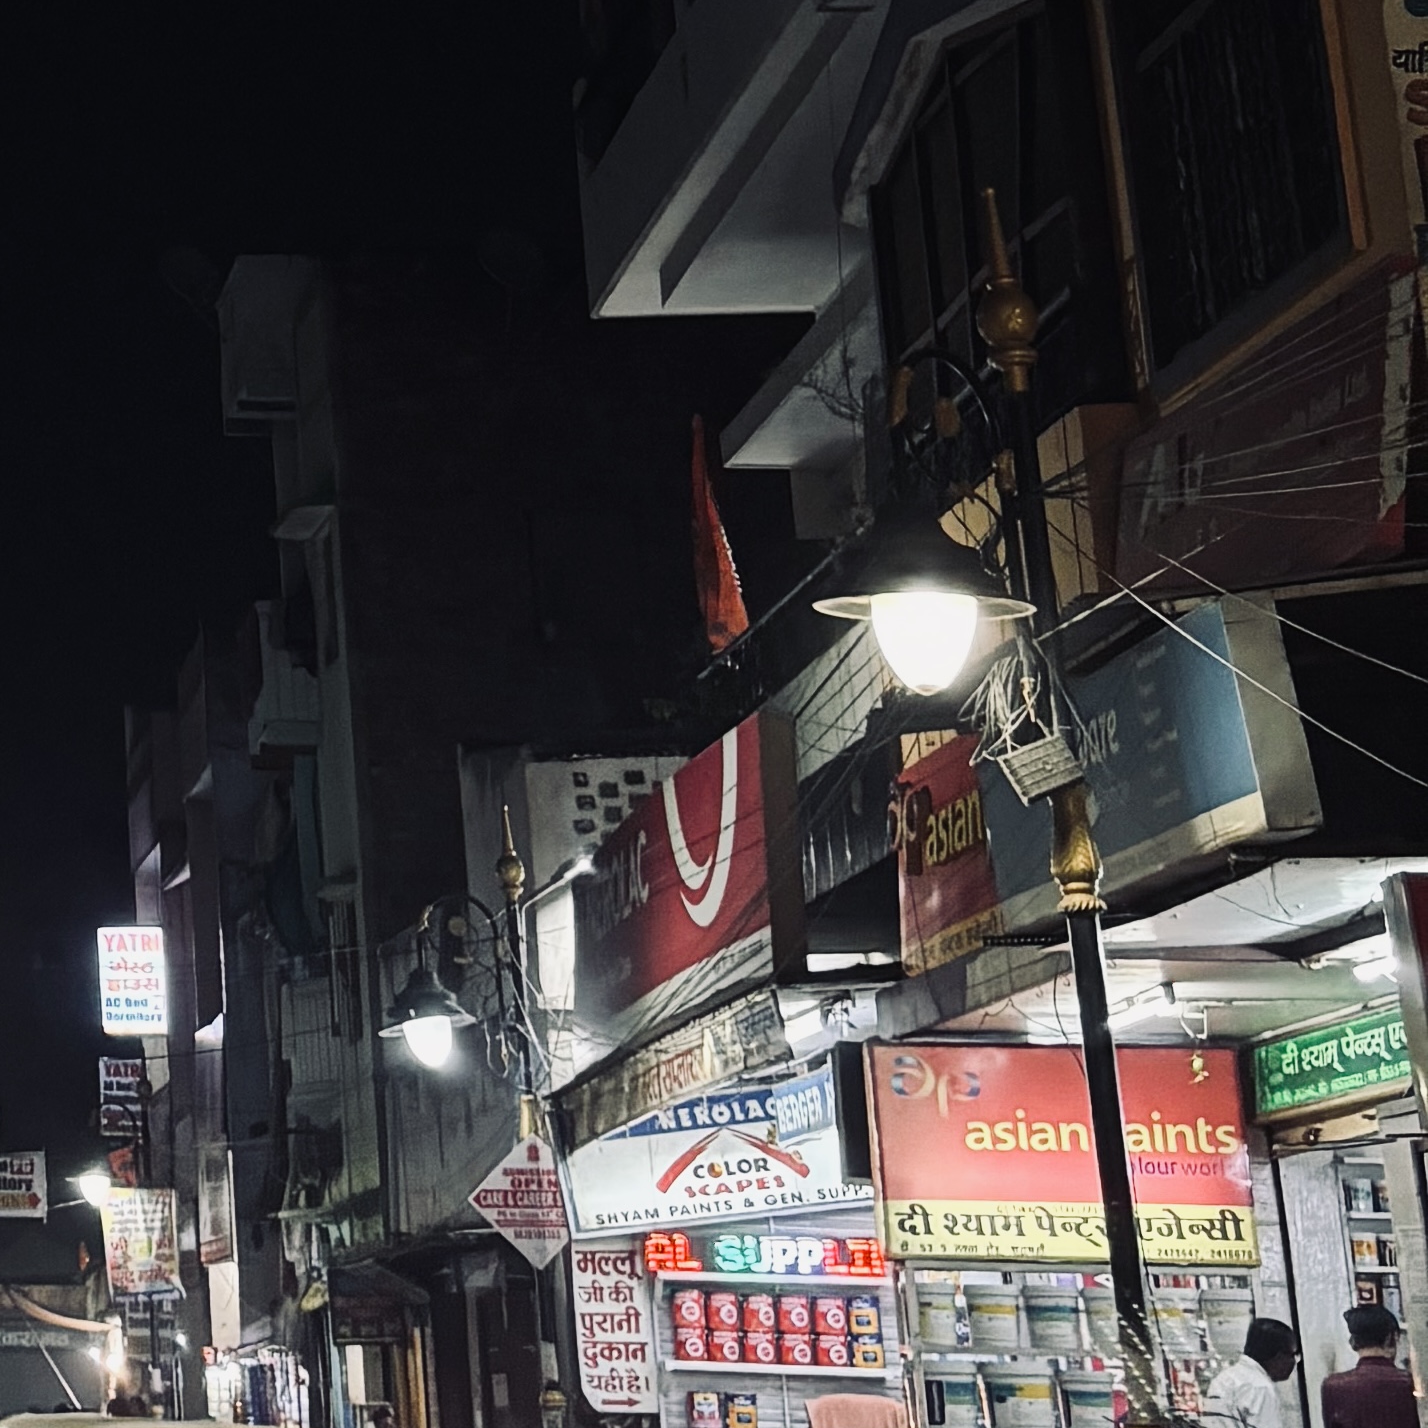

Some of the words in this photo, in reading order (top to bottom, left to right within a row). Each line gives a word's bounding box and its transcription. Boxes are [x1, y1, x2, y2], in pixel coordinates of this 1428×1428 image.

[103, 933, 159, 952] YATRI
[104, 1061, 143, 1078] YATR
[1281, 1042, 1299, 1075] दी
[657, 1096, 777, 1131] NEROLAC
[777, 1088, 823, 1133] BERGER
[510, 1176, 558, 1190] OPEN
[693, 1157, 772, 1180] COLOR
[684, 1175, 786, 1198] SCAPES
[596, 1207, 660, 1226] SHYAM
[669, 1199, 733, 1217] PAINTS
[743, 1196, 756, 1209] &
[764, 1190, 811, 1207] GEN.
[817, 1184, 870, 1201] SUPP.
[894, 1203, 934, 1236] दी
[943, 1212, 1026, 1237] श्याम
[575, 1249, 644, 1281] मल्लू
[578, 1281, 604, 1305] जी
[608, 1279, 634, 1305] की
[579, 1305, 643, 1340] पुरानी
[580, 1339, 649, 1370] दुकान
[586, 1370, 625, 1394] यही
